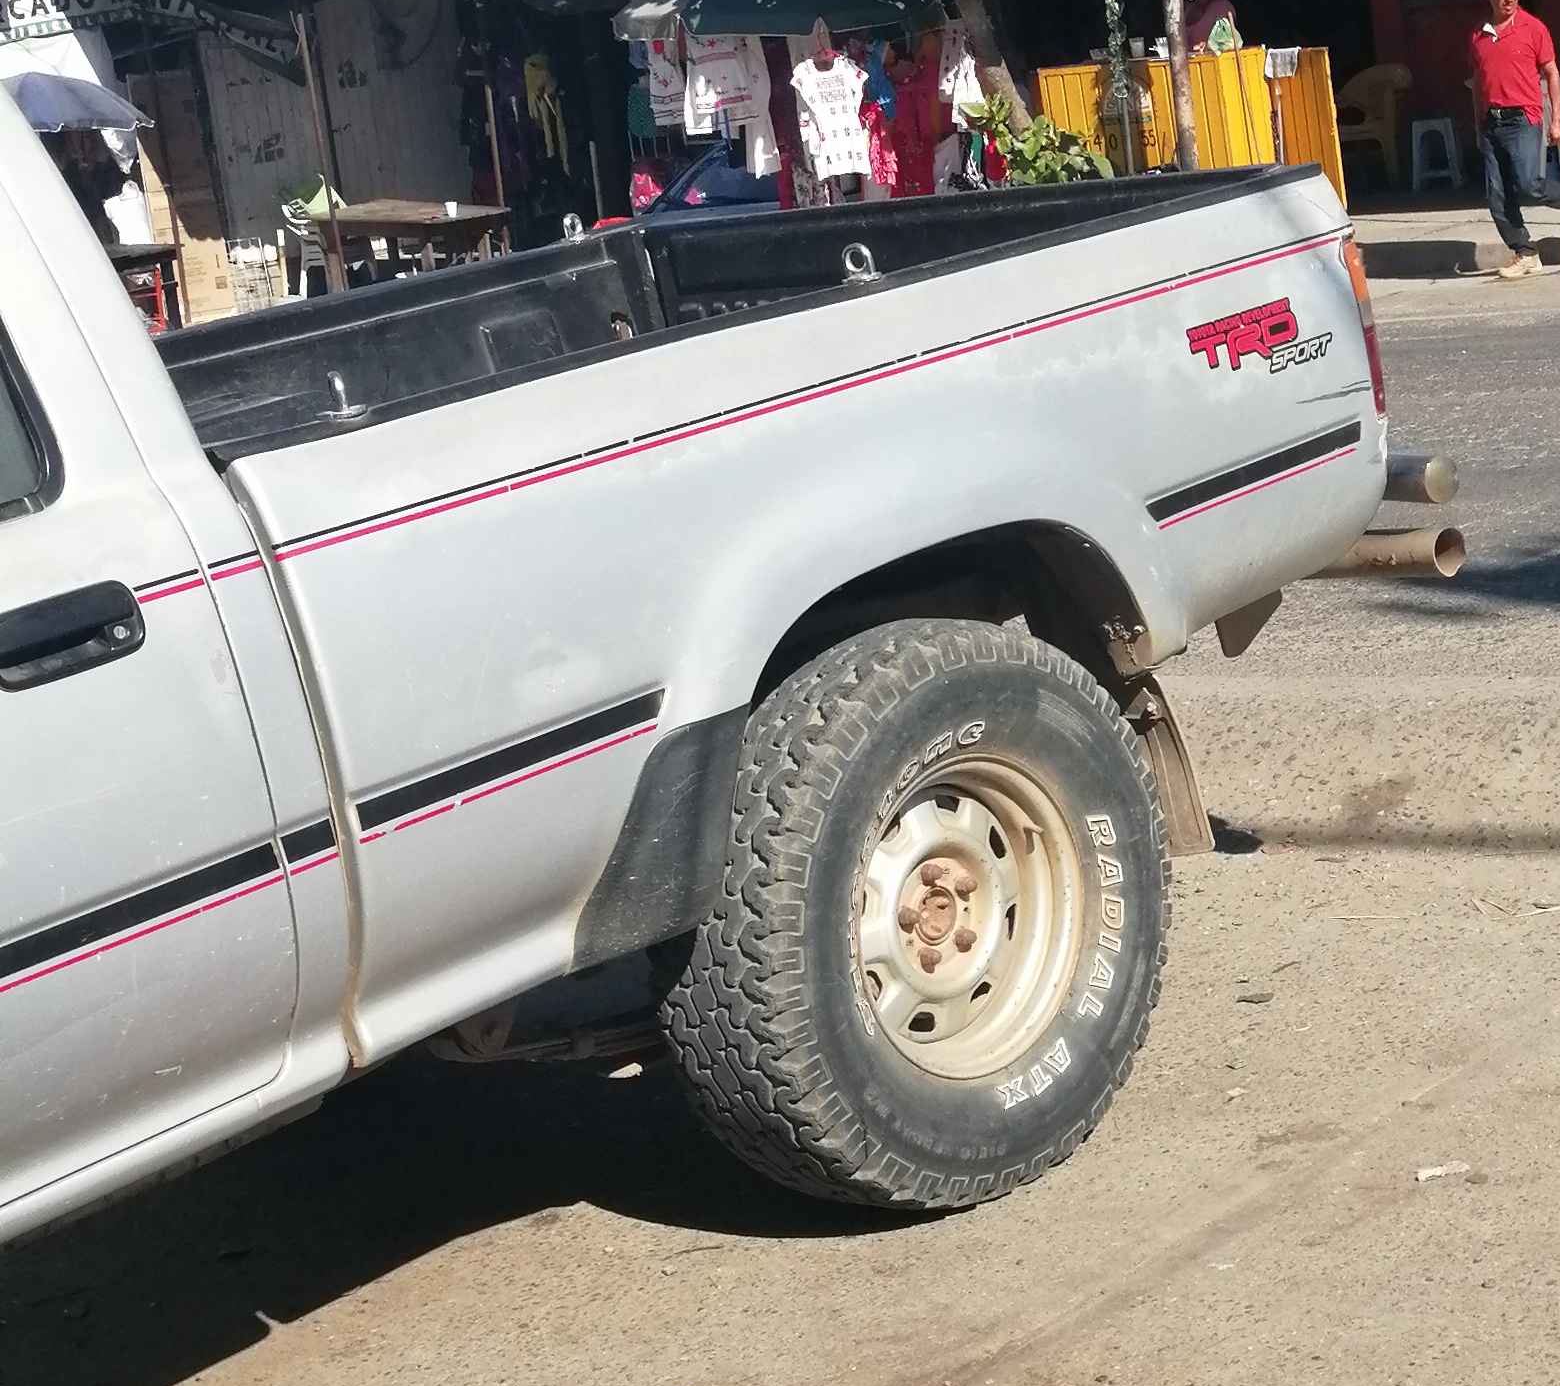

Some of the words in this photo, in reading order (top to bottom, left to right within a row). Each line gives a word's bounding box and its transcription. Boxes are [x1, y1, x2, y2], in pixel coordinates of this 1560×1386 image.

[1189, 311, 1299, 371] TRD
[1269, 332, 1333, 374] SPORT
[1077, 814, 1124, 1019] RADIAL
[994, 1037, 1072, 1110] ATX
